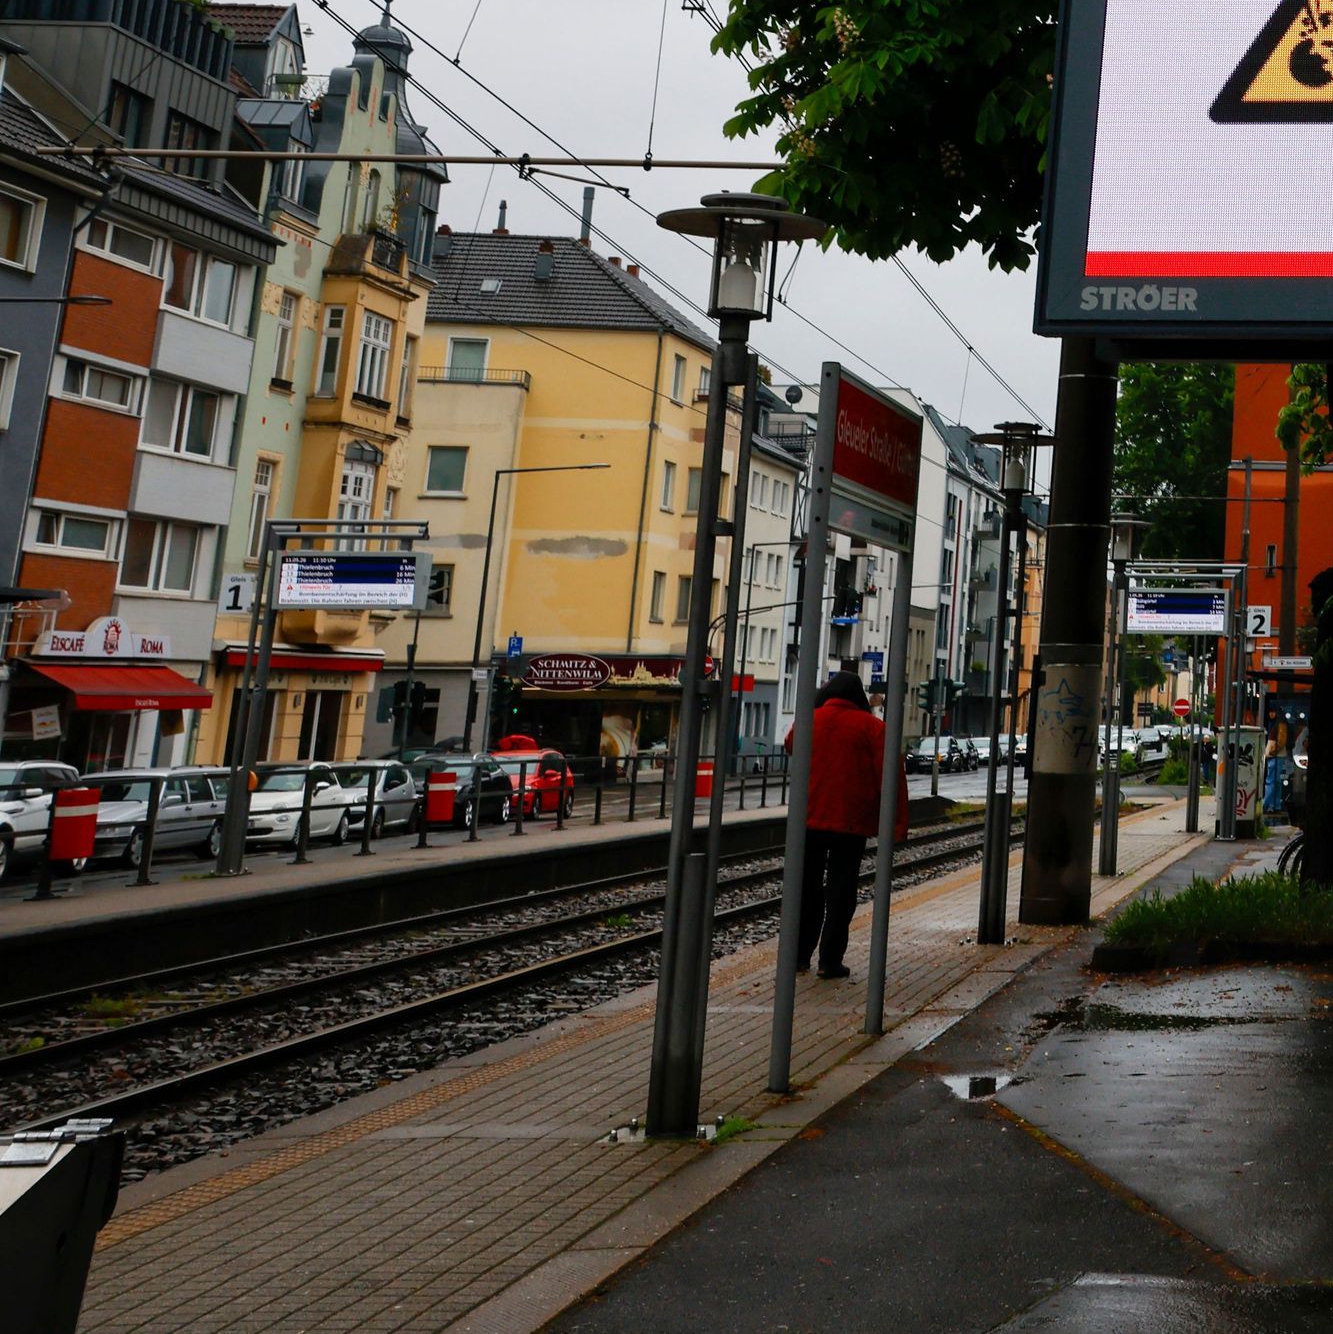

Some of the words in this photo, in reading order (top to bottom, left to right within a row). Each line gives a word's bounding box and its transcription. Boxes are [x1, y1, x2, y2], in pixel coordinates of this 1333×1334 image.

[1080, 284, 1198, 311] STRÖER
[226, 584, 243, 610] 1
[1252, 614, 1265, 634] 2
[529, 666, 602, 679] NITTENWILM
[537, 659, 587, 669] SCHMITZ
[589, 659, 597, 669] &
